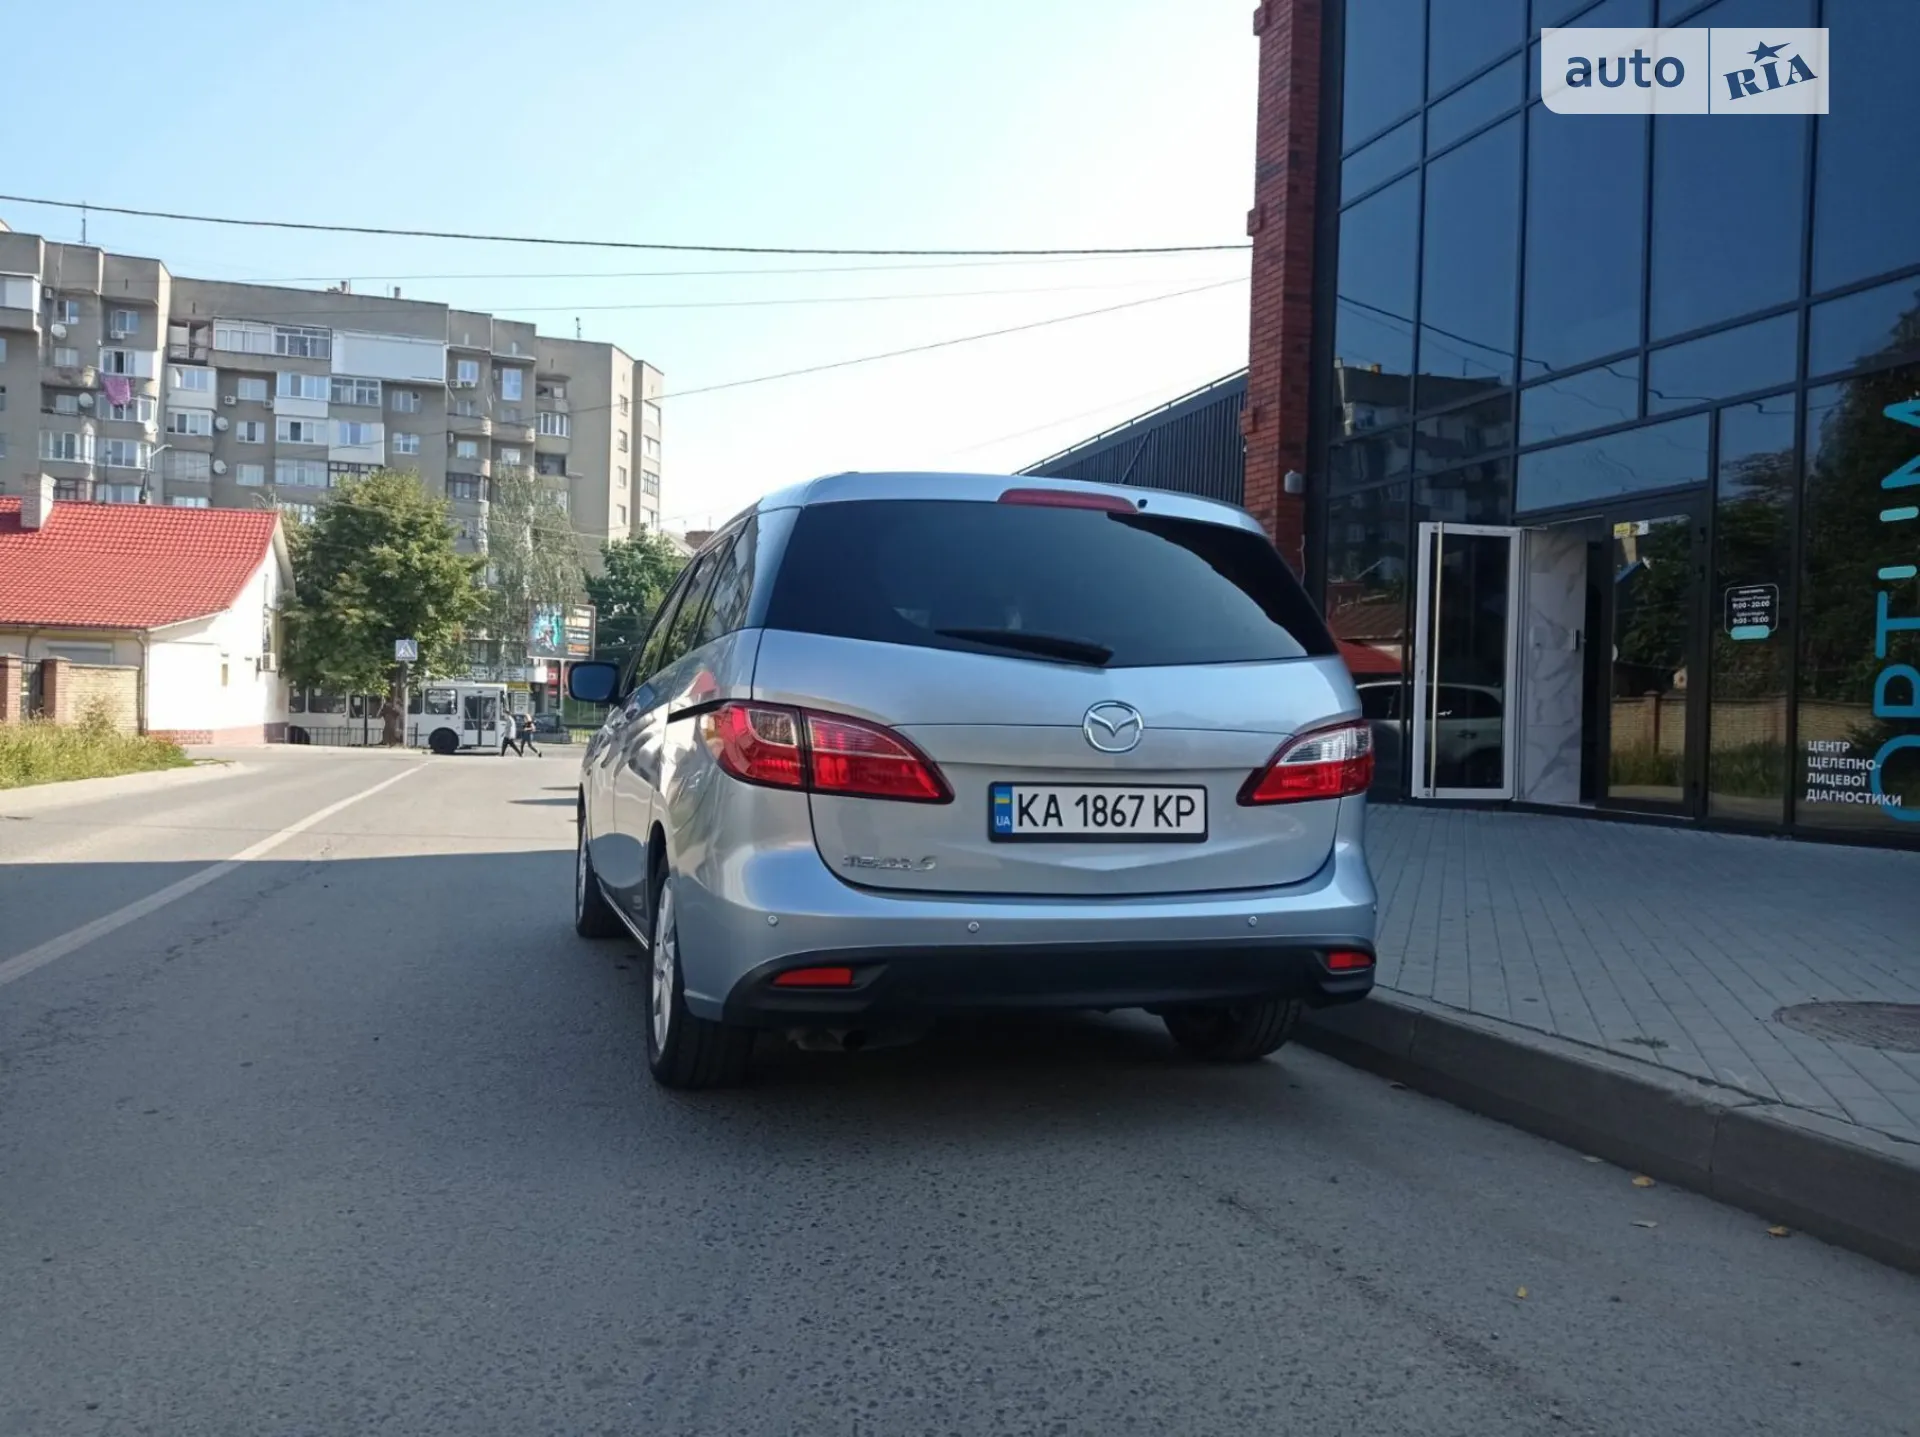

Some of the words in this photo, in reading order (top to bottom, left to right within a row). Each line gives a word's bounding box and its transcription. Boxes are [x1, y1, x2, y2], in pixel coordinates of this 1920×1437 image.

[1807, 740, 1850, 753] ЦЕНТР
[1807, 756, 1881, 771] ЩЕЛЕПНО-
[1806, 771, 1867, 787] ЛИЦЕВОЇ
[1805, 788, 1902, 807] ДІАГНОСТИКИ
[1017, 793, 1063, 827] KA
[1074, 794, 1145, 828] 1867
[1153, 794, 1196, 828] KP
[996, 815, 1011, 826] UA
